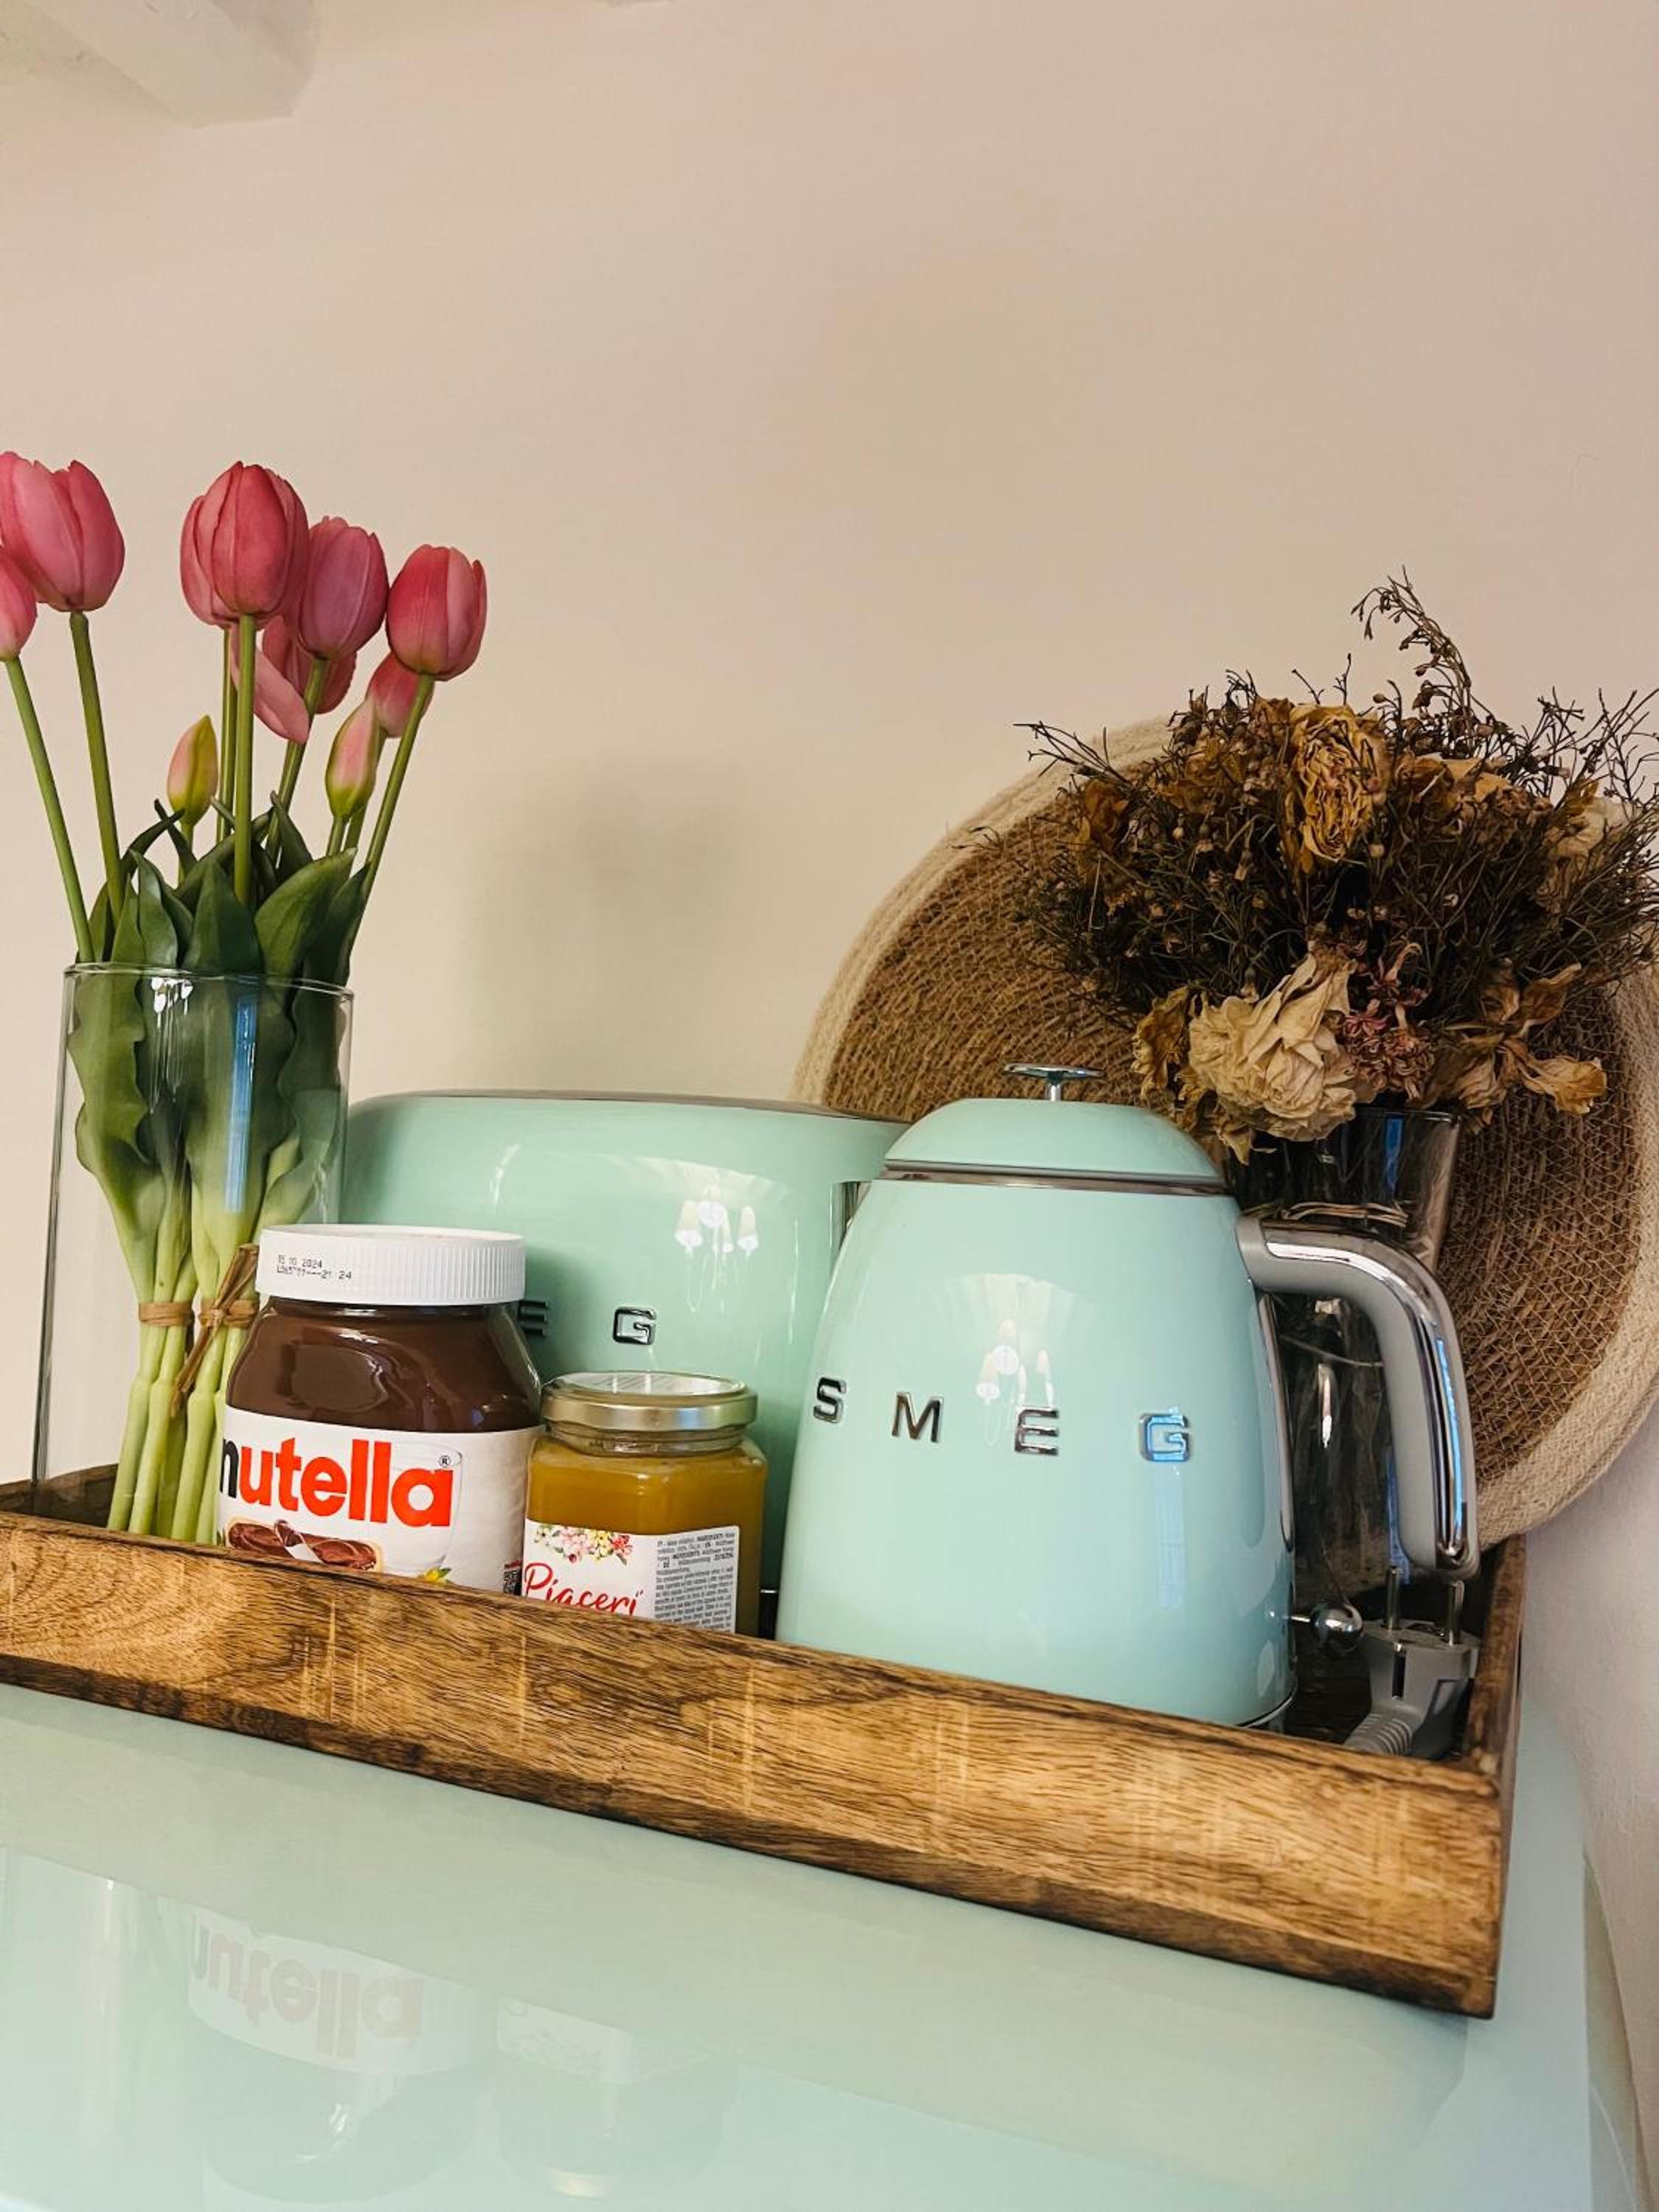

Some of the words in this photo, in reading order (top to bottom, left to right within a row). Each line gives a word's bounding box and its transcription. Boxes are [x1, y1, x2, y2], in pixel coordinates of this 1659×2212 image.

[302, 1259, 323, 1268] 2024
[518, 1300, 656, 1346] EG
[813, 1376, 1192, 1463] SMEG
[220, 1437, 453, 1528] nutella
[524, 1562, 644, 1616] Piaceri
